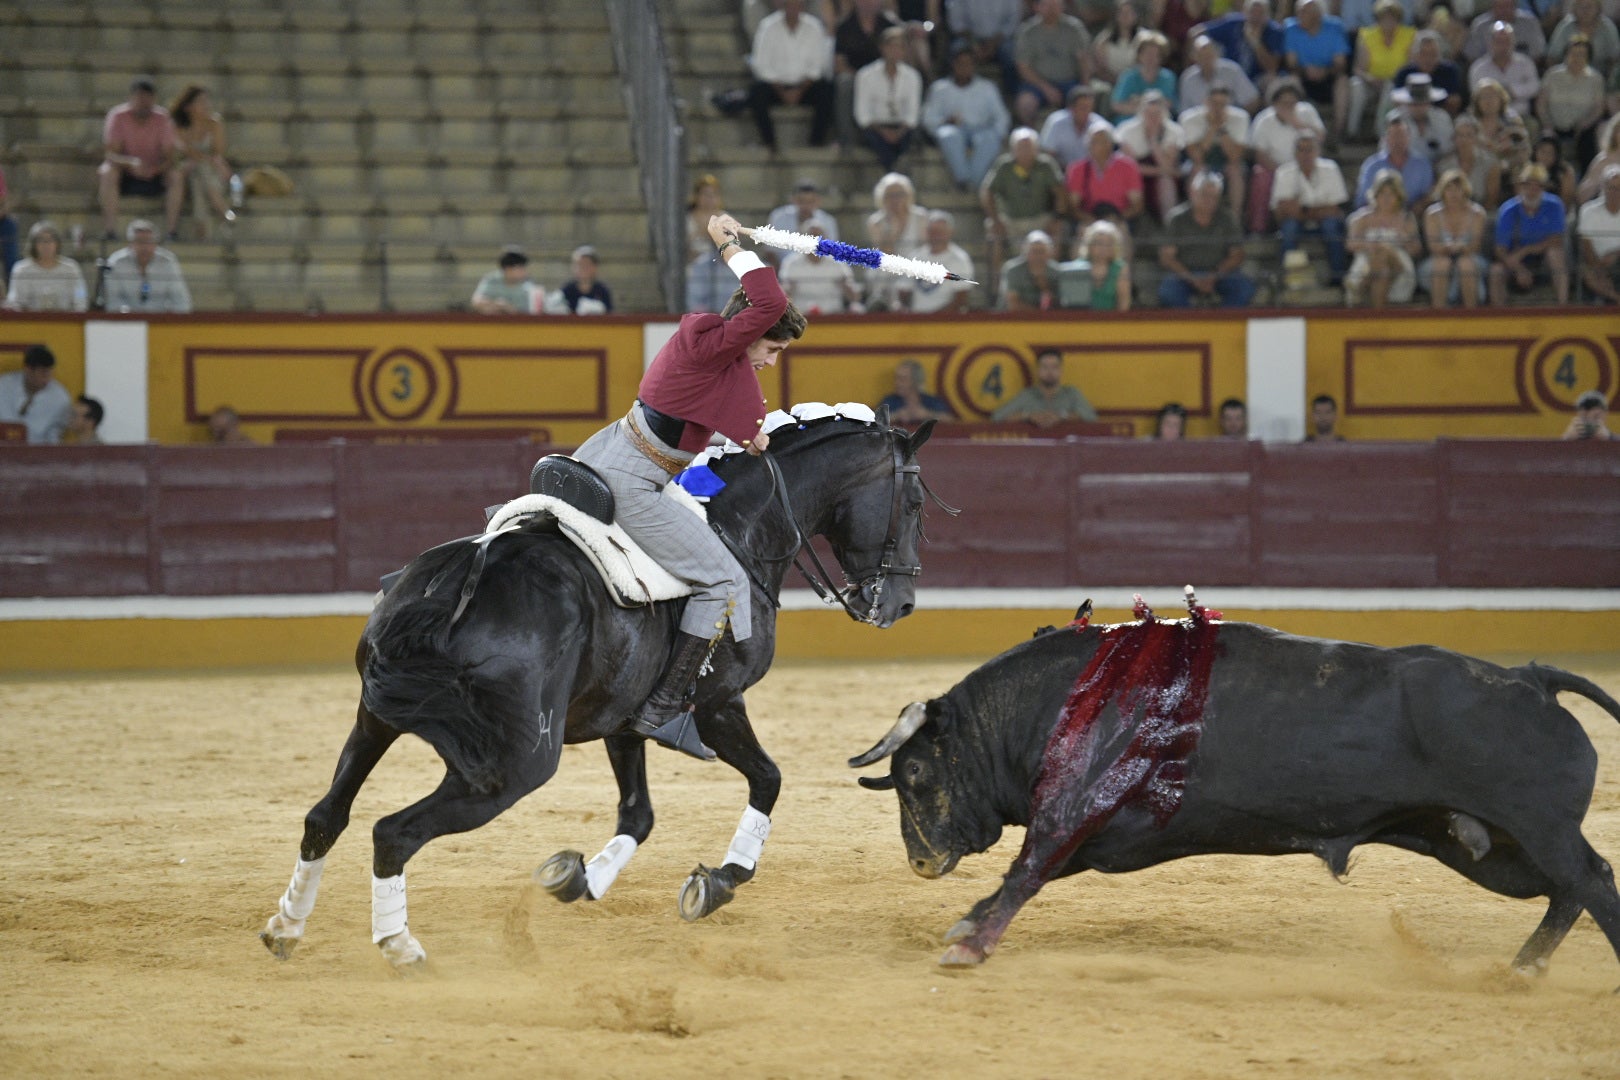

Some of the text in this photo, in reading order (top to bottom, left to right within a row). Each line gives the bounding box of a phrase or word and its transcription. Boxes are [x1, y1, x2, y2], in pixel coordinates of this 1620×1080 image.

[391, 365, 411, 400] 3
[982, 365, 1003, 399] 4
[1554, 354, 1577, 389] 4
